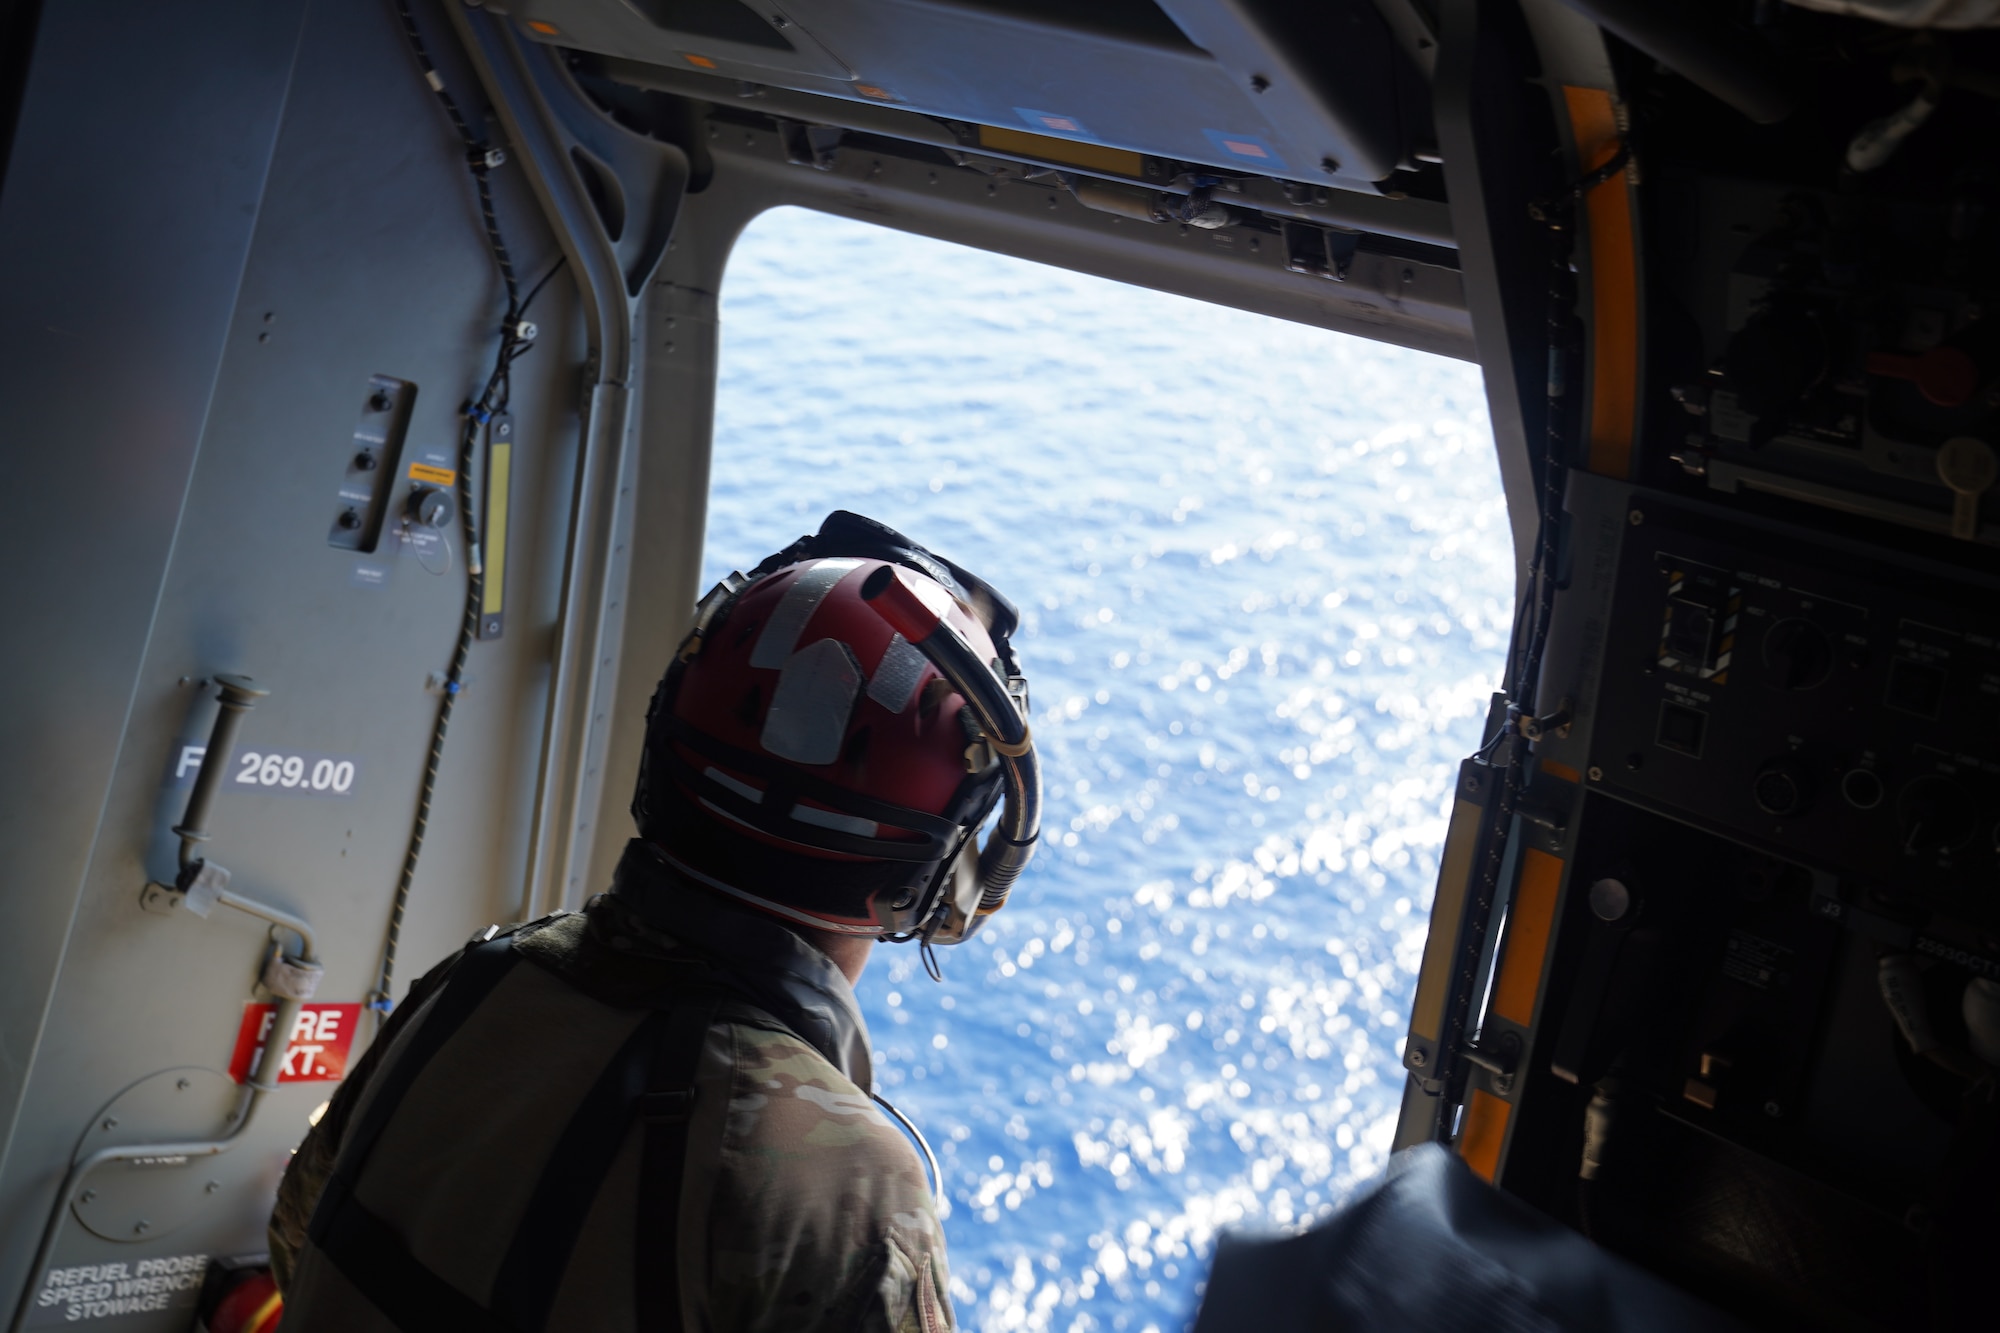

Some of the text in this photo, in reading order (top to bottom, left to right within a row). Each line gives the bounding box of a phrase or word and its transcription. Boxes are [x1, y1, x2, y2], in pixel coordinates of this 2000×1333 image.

[236, 751, 355, 793] 269.00
[1820, 900, 1843, 918] J3
[256, 1009, 343, 1042] FRE
[46, 1254, 208, 1289] REFUEL PROBE
[37, 1273, 205, 1308] SPEED WRENCH
[65, 1293, 171, 1322] STOWAGE
